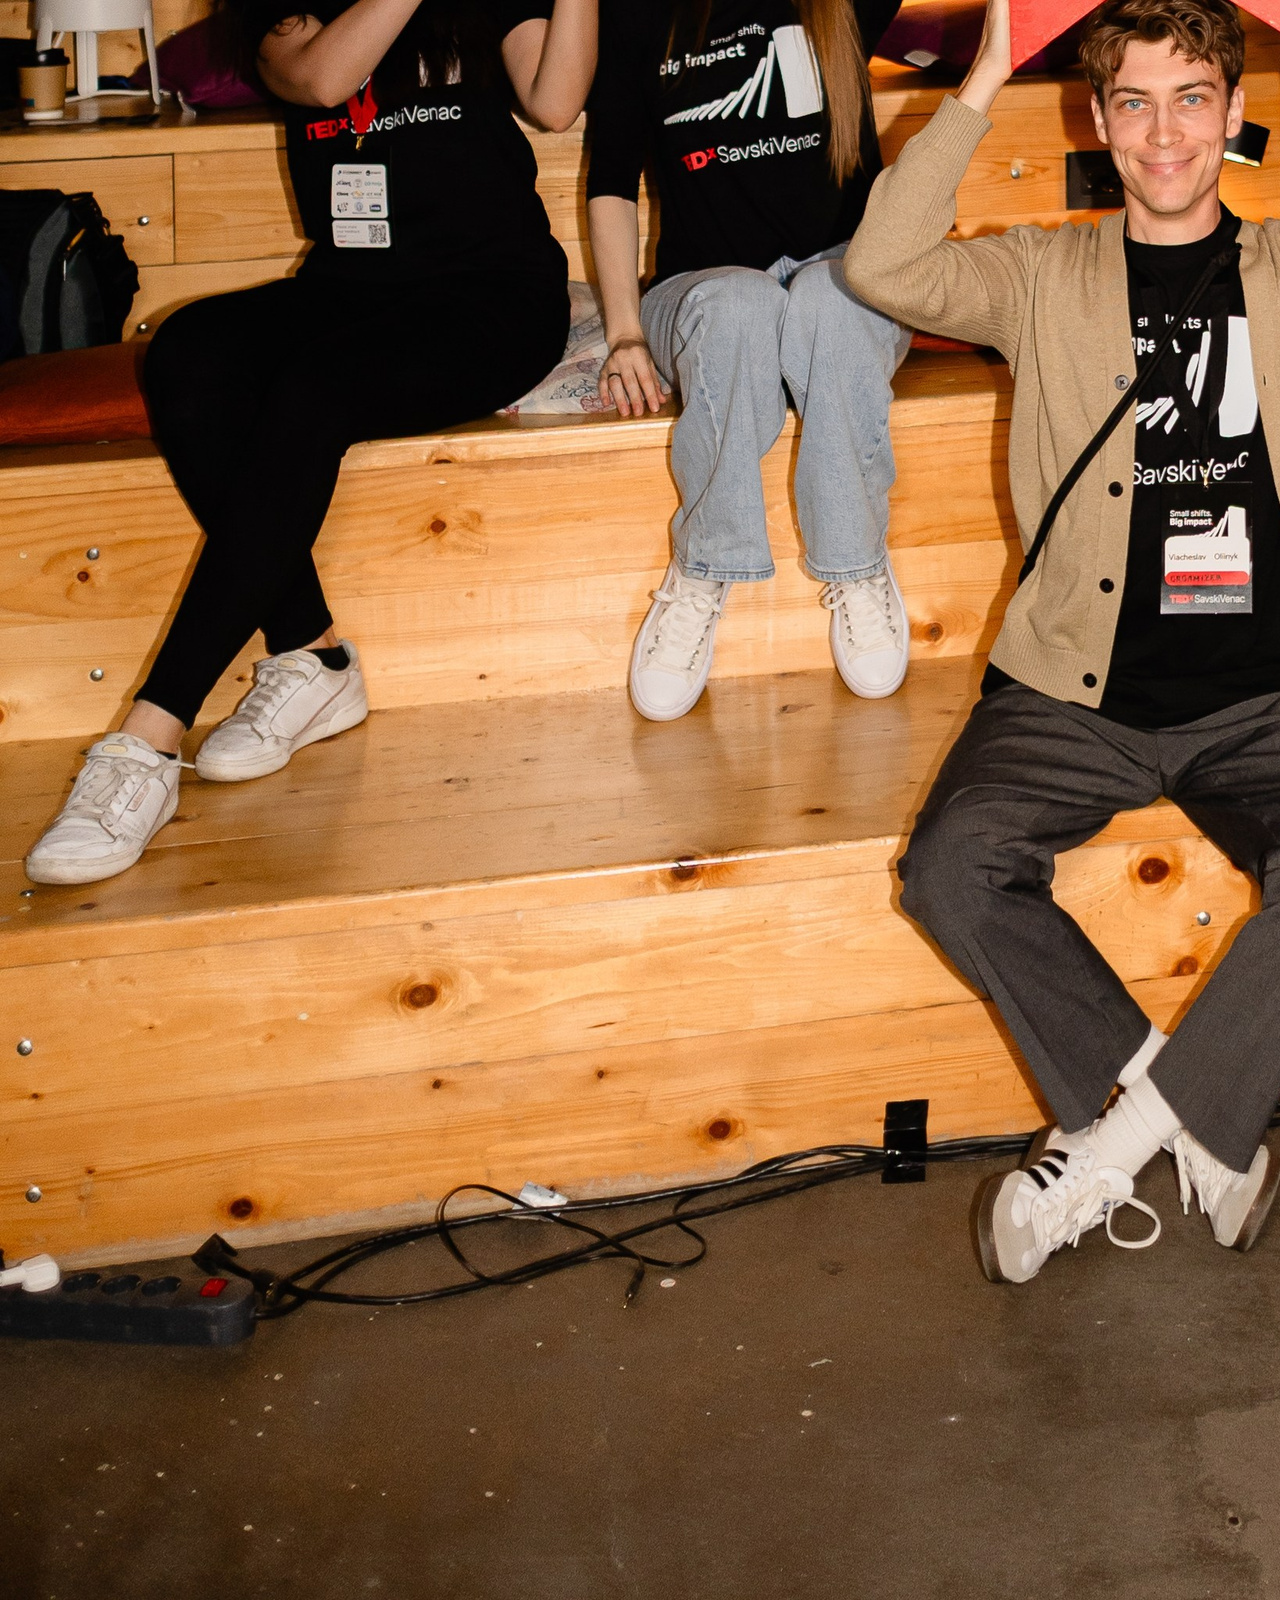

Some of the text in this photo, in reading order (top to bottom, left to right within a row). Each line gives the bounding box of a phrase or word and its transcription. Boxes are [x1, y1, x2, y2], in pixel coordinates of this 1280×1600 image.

[737, 22, 766, 38] shifts
[685, 42, 747, 68] impact
[716, 132, 822, 164] SavskiVenac
[1133, 450, 1250, 486] SavskiVec
[1169, 509, 1190, 518] Small
[1169, 517, 1183, 528] Big
[1168, 552, 1207, 562] Viacheslav
[1194, 593, 1247, 604] SavskiVenac
